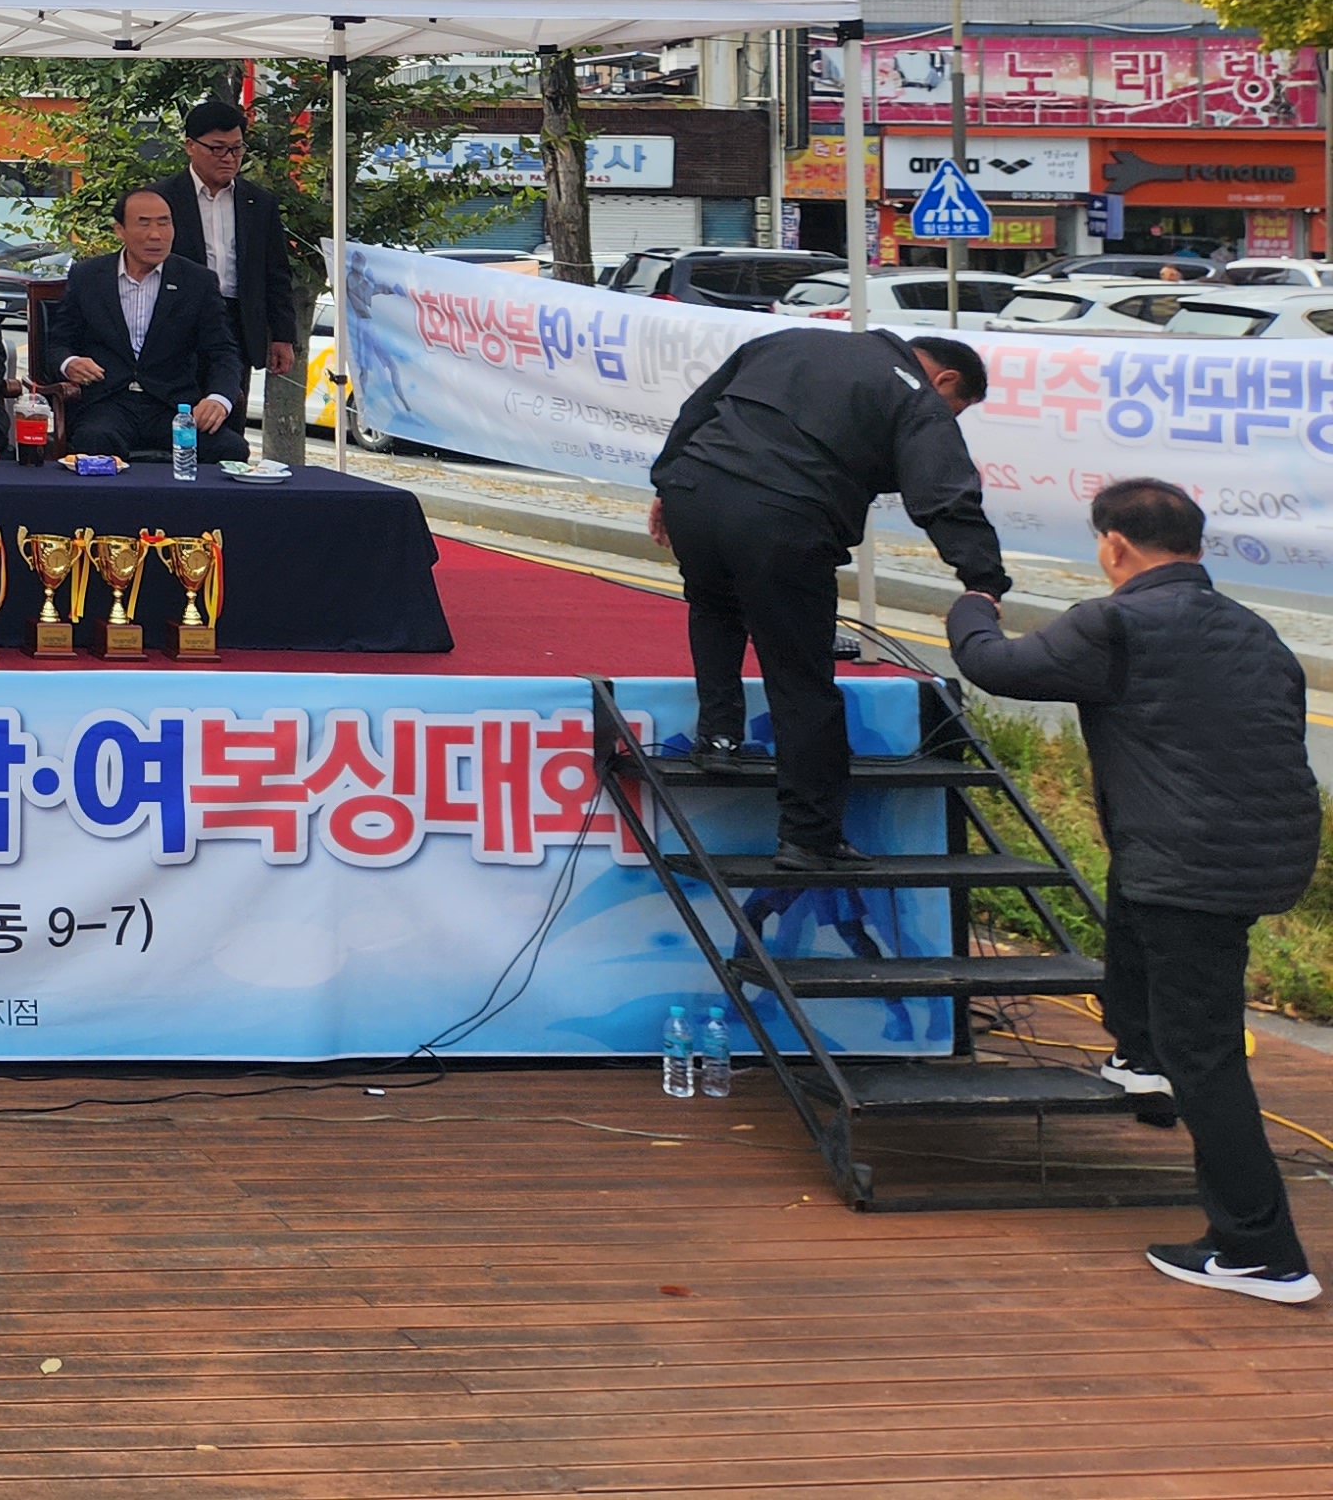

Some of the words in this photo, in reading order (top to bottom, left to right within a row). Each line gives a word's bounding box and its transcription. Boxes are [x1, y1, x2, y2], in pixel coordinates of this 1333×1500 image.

[1004, 50, 1279, 109] 노래방
[1187, 164, 1296, 183] renoma
[923, 223, 980, 234] 횡단보도
[46, 899, 155, 954] 9-7)
